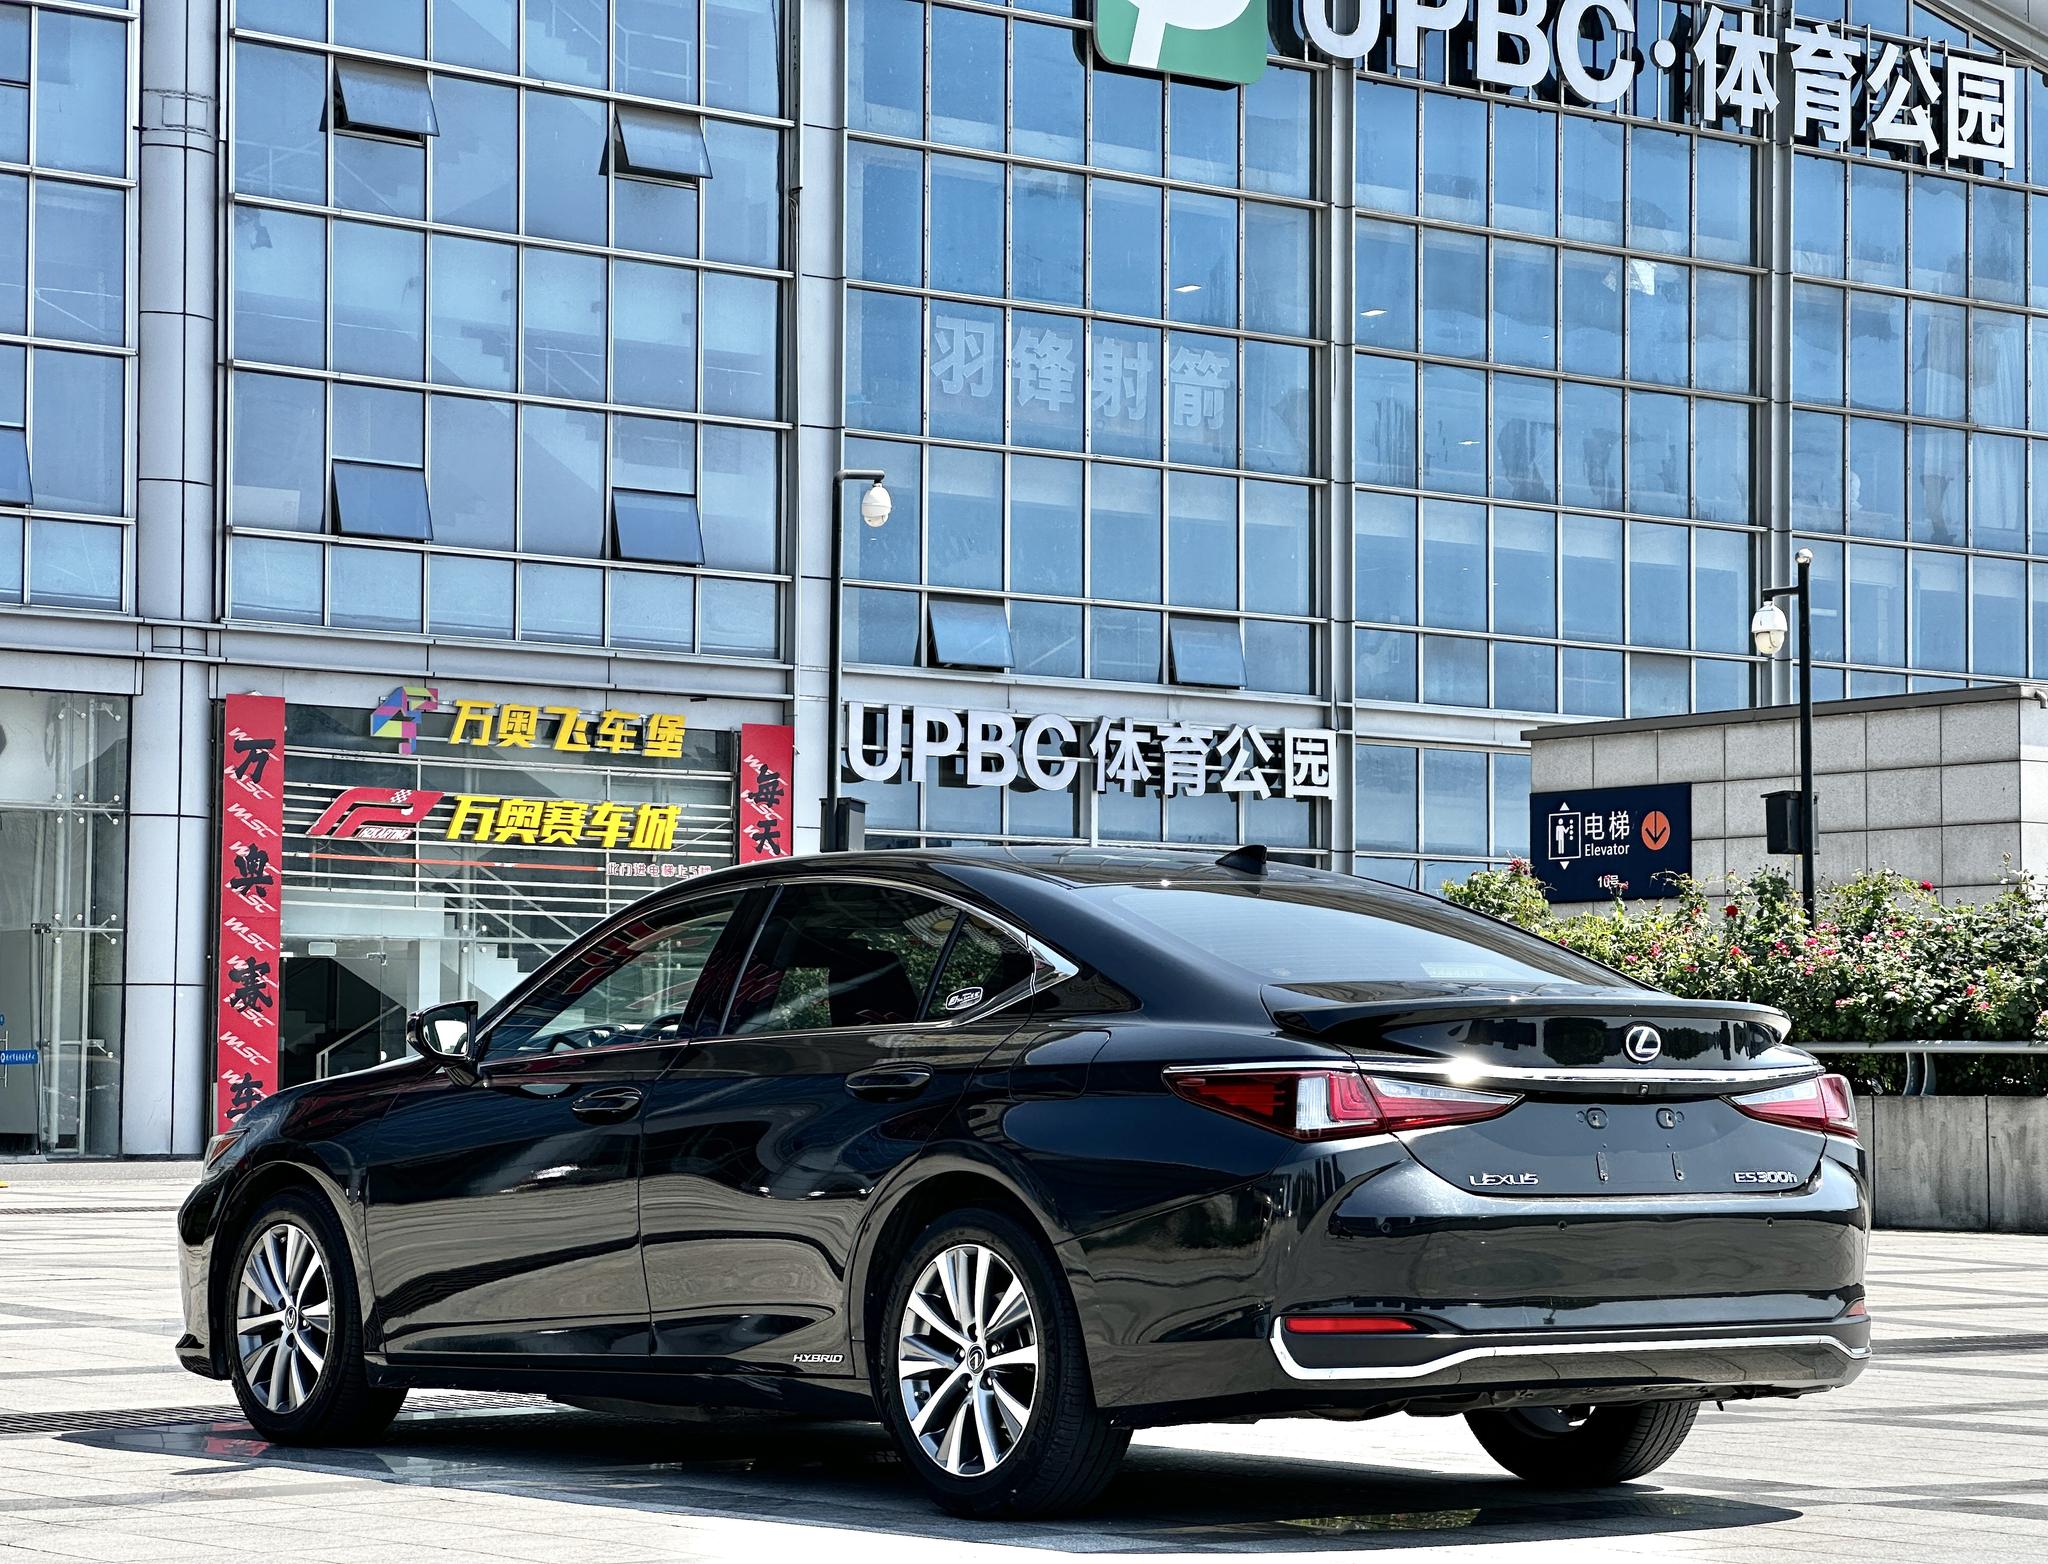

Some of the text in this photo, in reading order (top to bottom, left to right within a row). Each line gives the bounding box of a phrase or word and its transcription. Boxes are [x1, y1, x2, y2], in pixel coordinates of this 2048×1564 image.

[930, 315, 1232, 430] 羽锋射箭
[448, 699, 688, 759] 万奥飞车堡
[446, 795, 683, 850] 万奥赛车城
[1584, 810, 1631, 841] 电梯
[1584, 843, 1631, 857] Elevator
[1469, 1172, 1539, 1186] LEXUS
[792, 1354, 844, 1363] HYBRID
